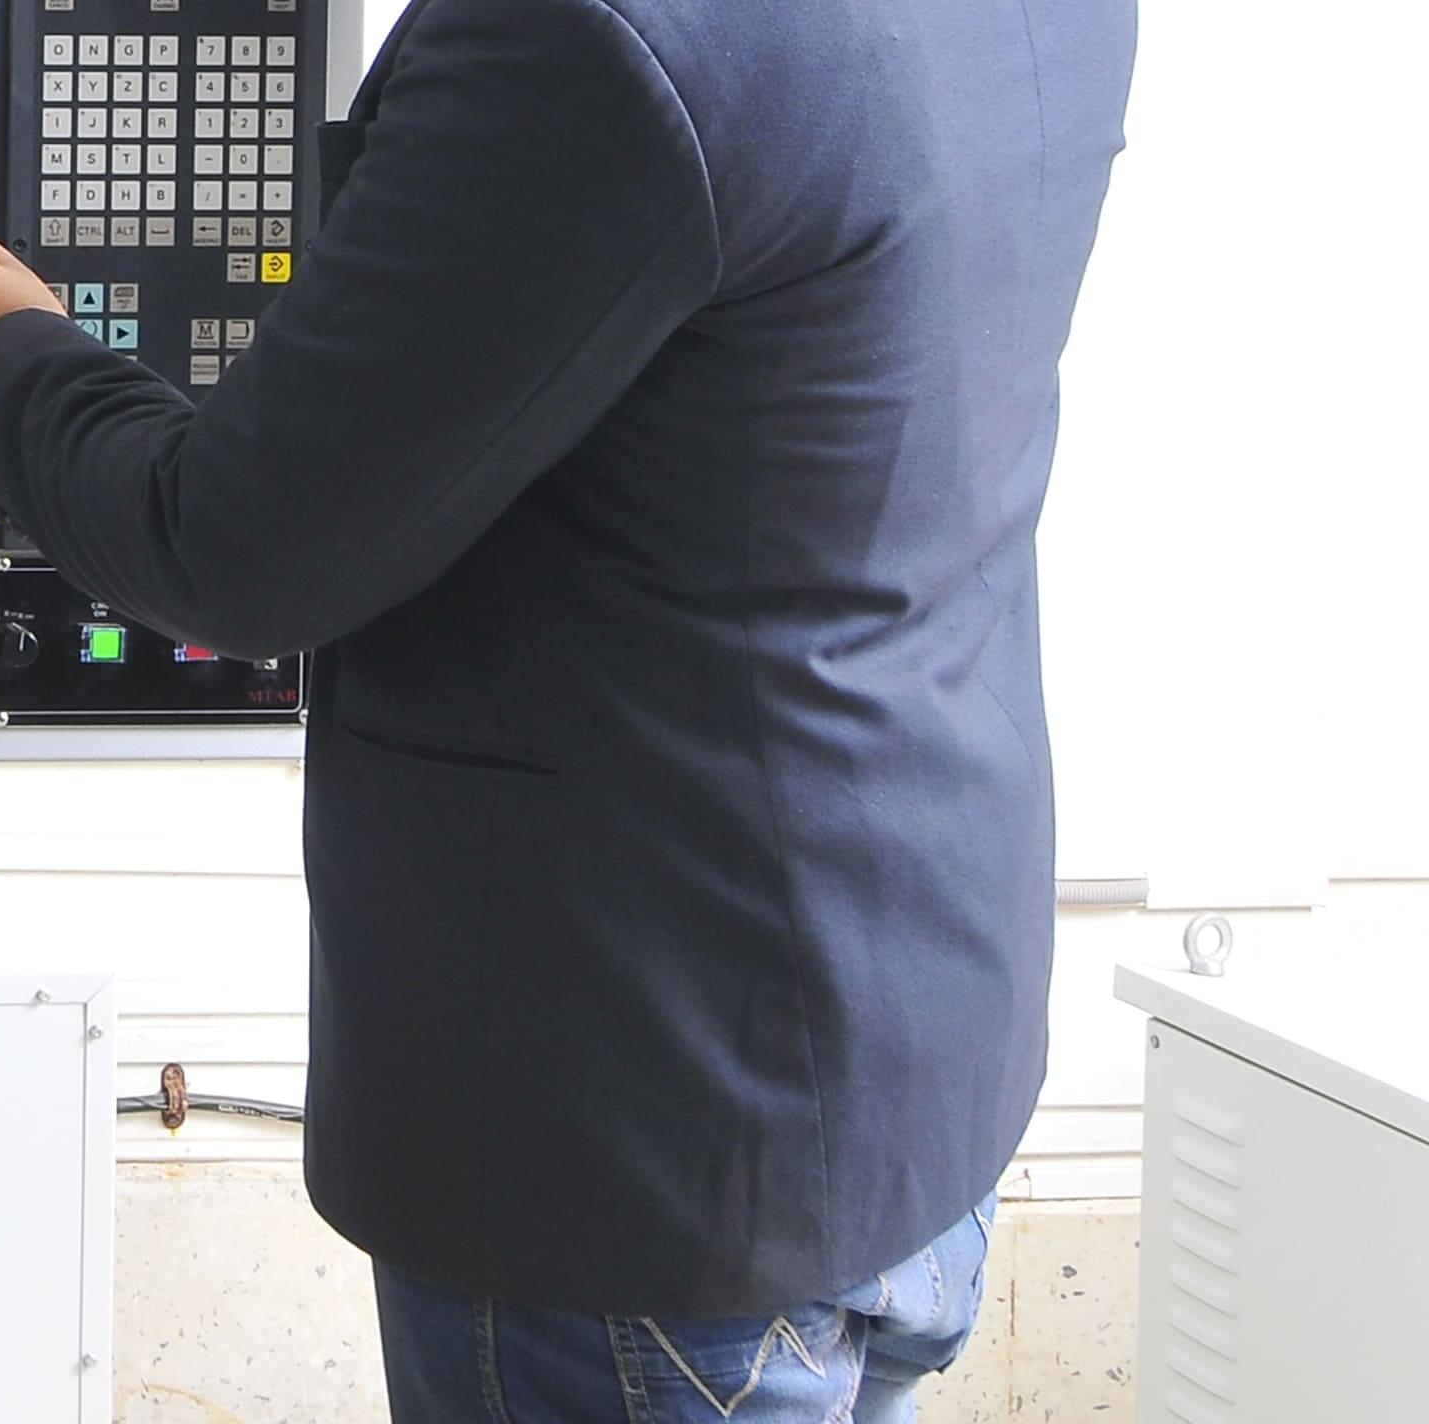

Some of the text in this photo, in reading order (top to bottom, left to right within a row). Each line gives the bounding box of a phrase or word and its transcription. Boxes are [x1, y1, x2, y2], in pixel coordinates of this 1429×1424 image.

[54, 44, 63, 55] O
[89, 45, 98, 55] N
[124, 45, 133, 56] G
[160, 45, 168, 55] P
[208, 45, 215, 55] 7
[243, 46, 249, 56] 8
[277, 46, 285, 56] 9
[54, 81, 62, 91] X
[89, 81, 97, 91] Y
[124, 81, 132, 92] Z
[159, 81, 167, 92] C
[206, 82, 213, 91] 4
[242, 82, 249, 92] 5
[277, 82, 284, 92] 6
[89, 117, 96, 128] J
[123, 118, 130, 128] K
[158, 117, 166, 128] R
[208, 118, 212, 128] 1
[241, 118, 248, 128] 2
[276, 118, 283, 128] 3
[51, 154, 62, 163] M
[88, 153, 96, 164] S
[123, 153, 130, 164] T
[158, 154, 165, 164] L
[240, 154, 247, 164] 0
[53, 190, 58, 200] F
[86, 190, 95, 200] D
[122, 190, 130, 200] H
[157, 190, 165, 200] B
[76, 225, 101, 236] CTRL
[117, 226, 134, 235] ALT
[232, 227, 251, 235] DEL
[249, 690, 297, 702] MTAB
